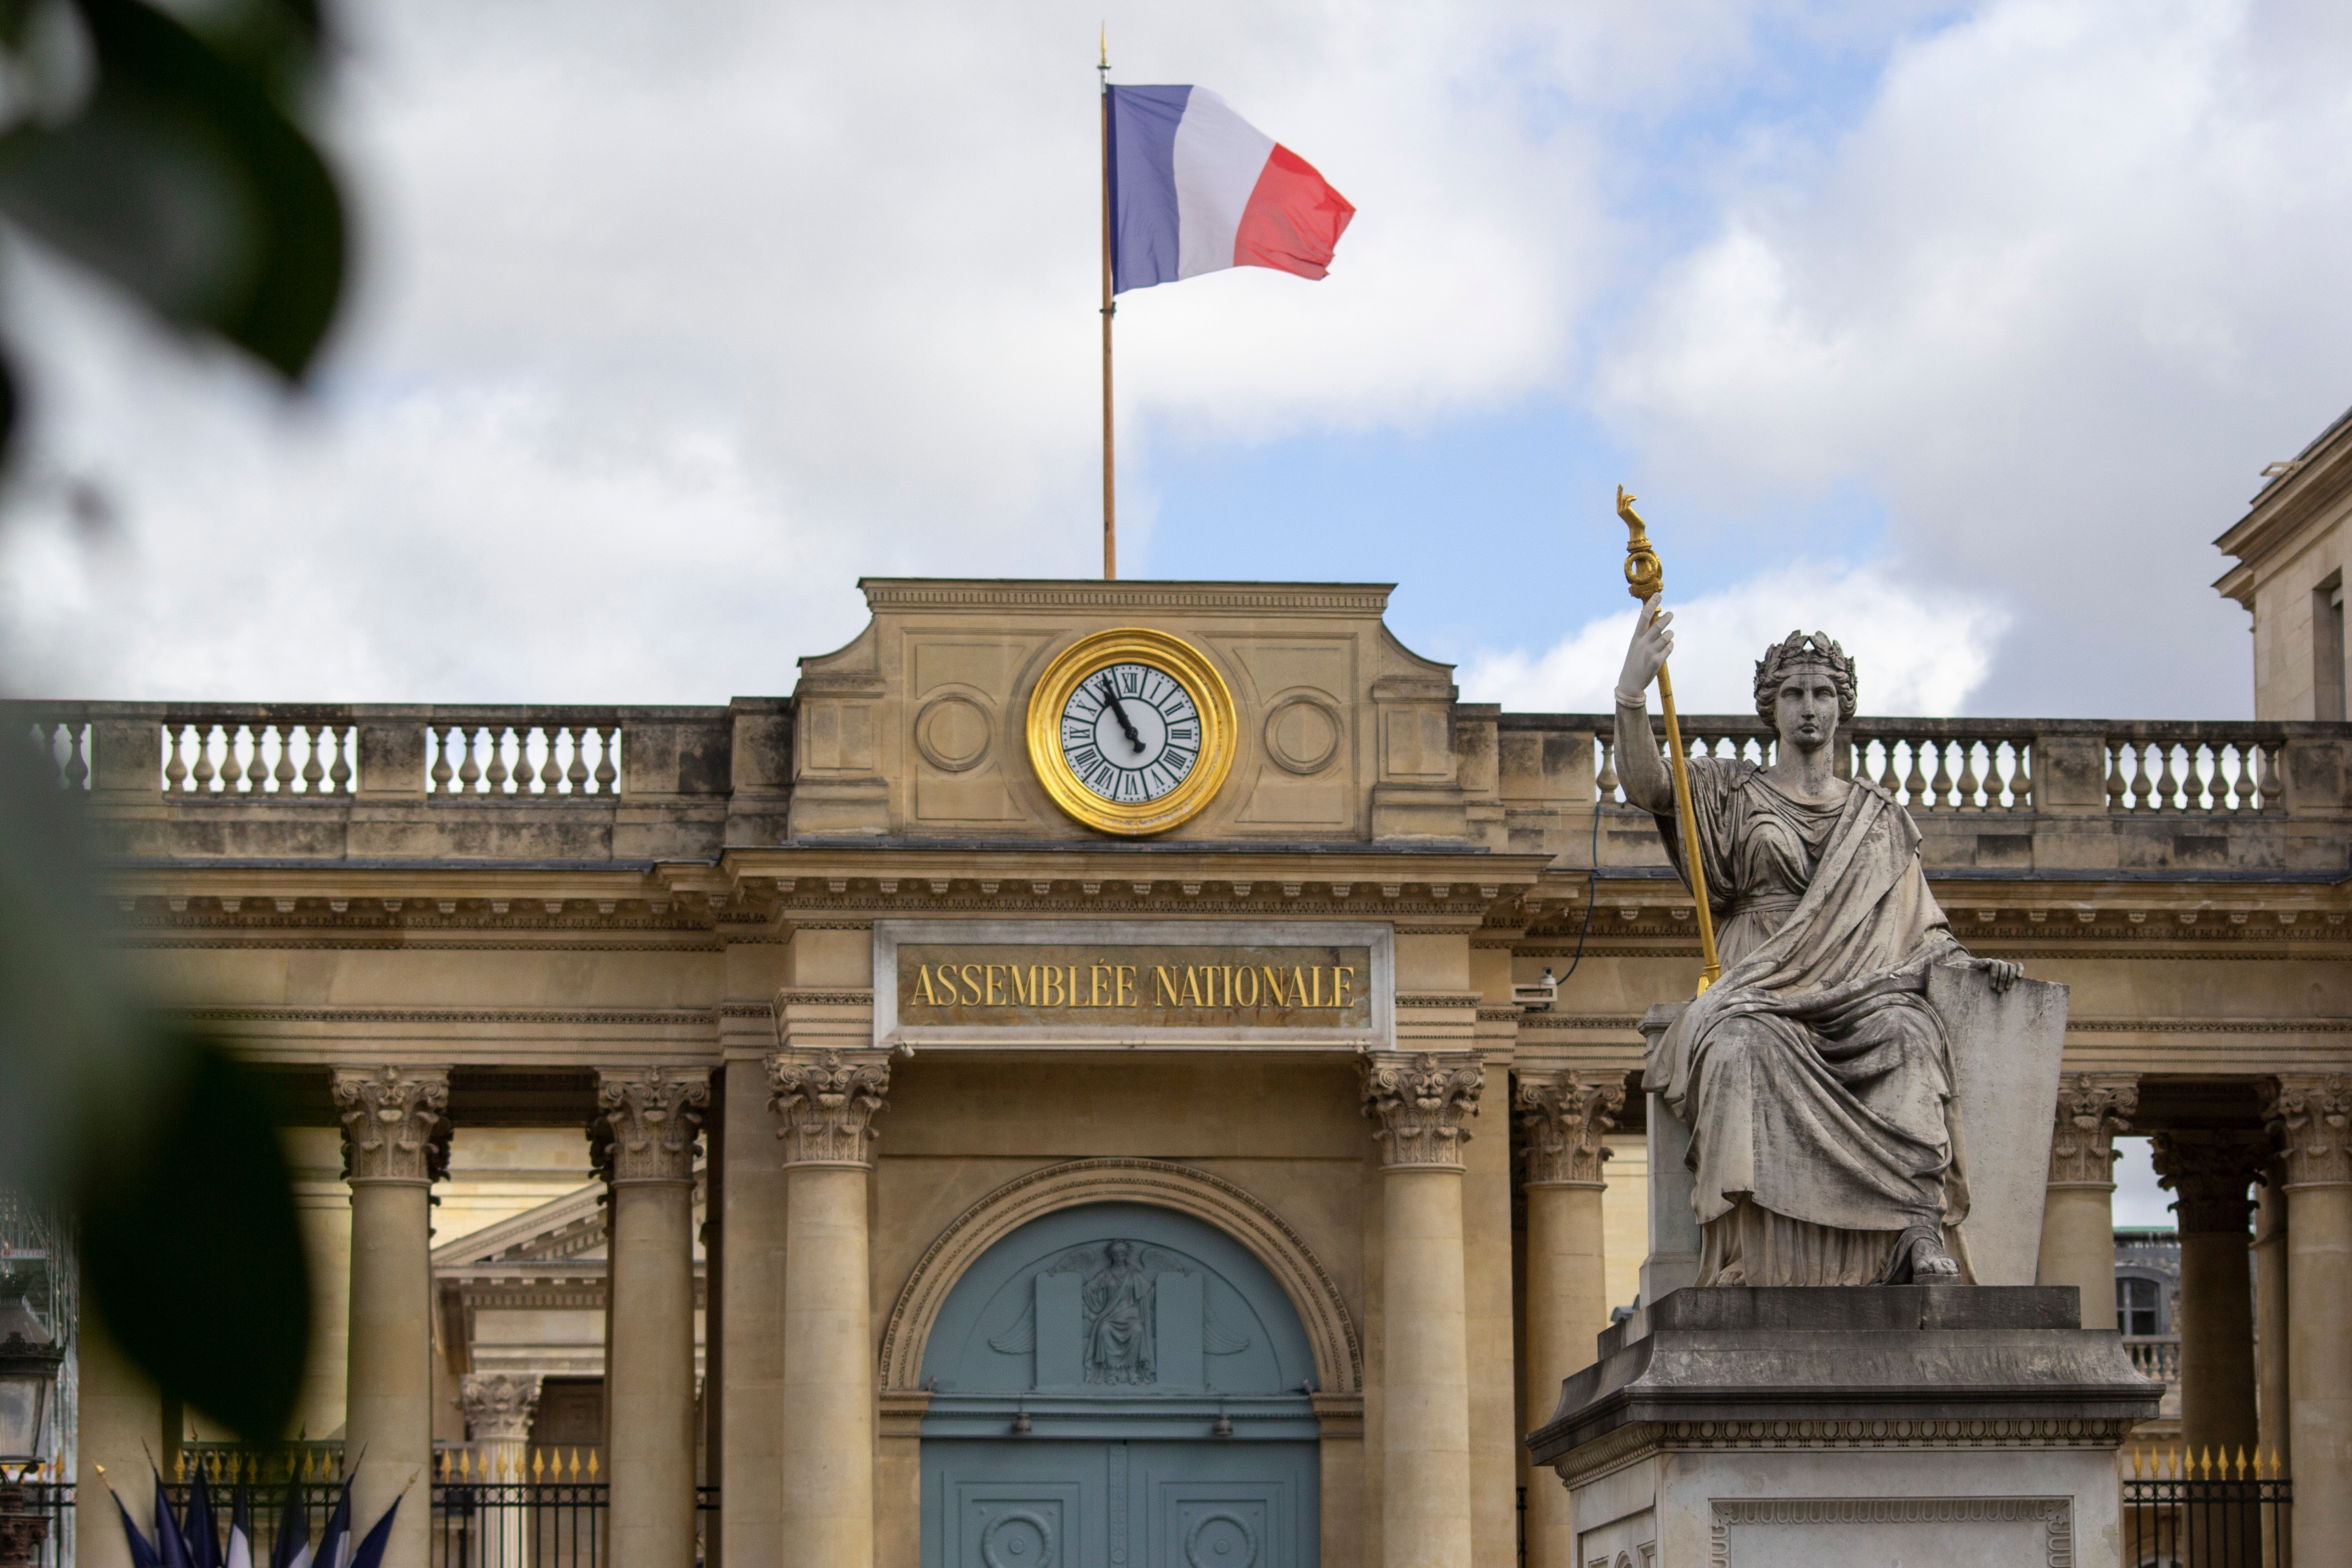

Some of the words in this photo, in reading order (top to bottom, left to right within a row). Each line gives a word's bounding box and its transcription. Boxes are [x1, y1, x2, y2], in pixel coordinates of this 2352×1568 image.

[1121, 673, 1138, 694] XII
[1149, 681, 1163, 700] I
[1076, 700, 1098, 717] X
[1164, 701, 1185, 717] II
[1070, 726, 1090, 740] IX
[1171, 728, 1192, 740] III
[1074, 747, 1100, 774] VIII
[1163, 749, 1187, 770] IIII
[1094, 765, 1114, 790] VII
[1125, 774, 1139, 794] VI
[1150, 768, 1166, 789] V
[910, 958, 1137, 1007] ASSEMBLÉE
[1156, 965, 1355, 1008] NATIONALE
